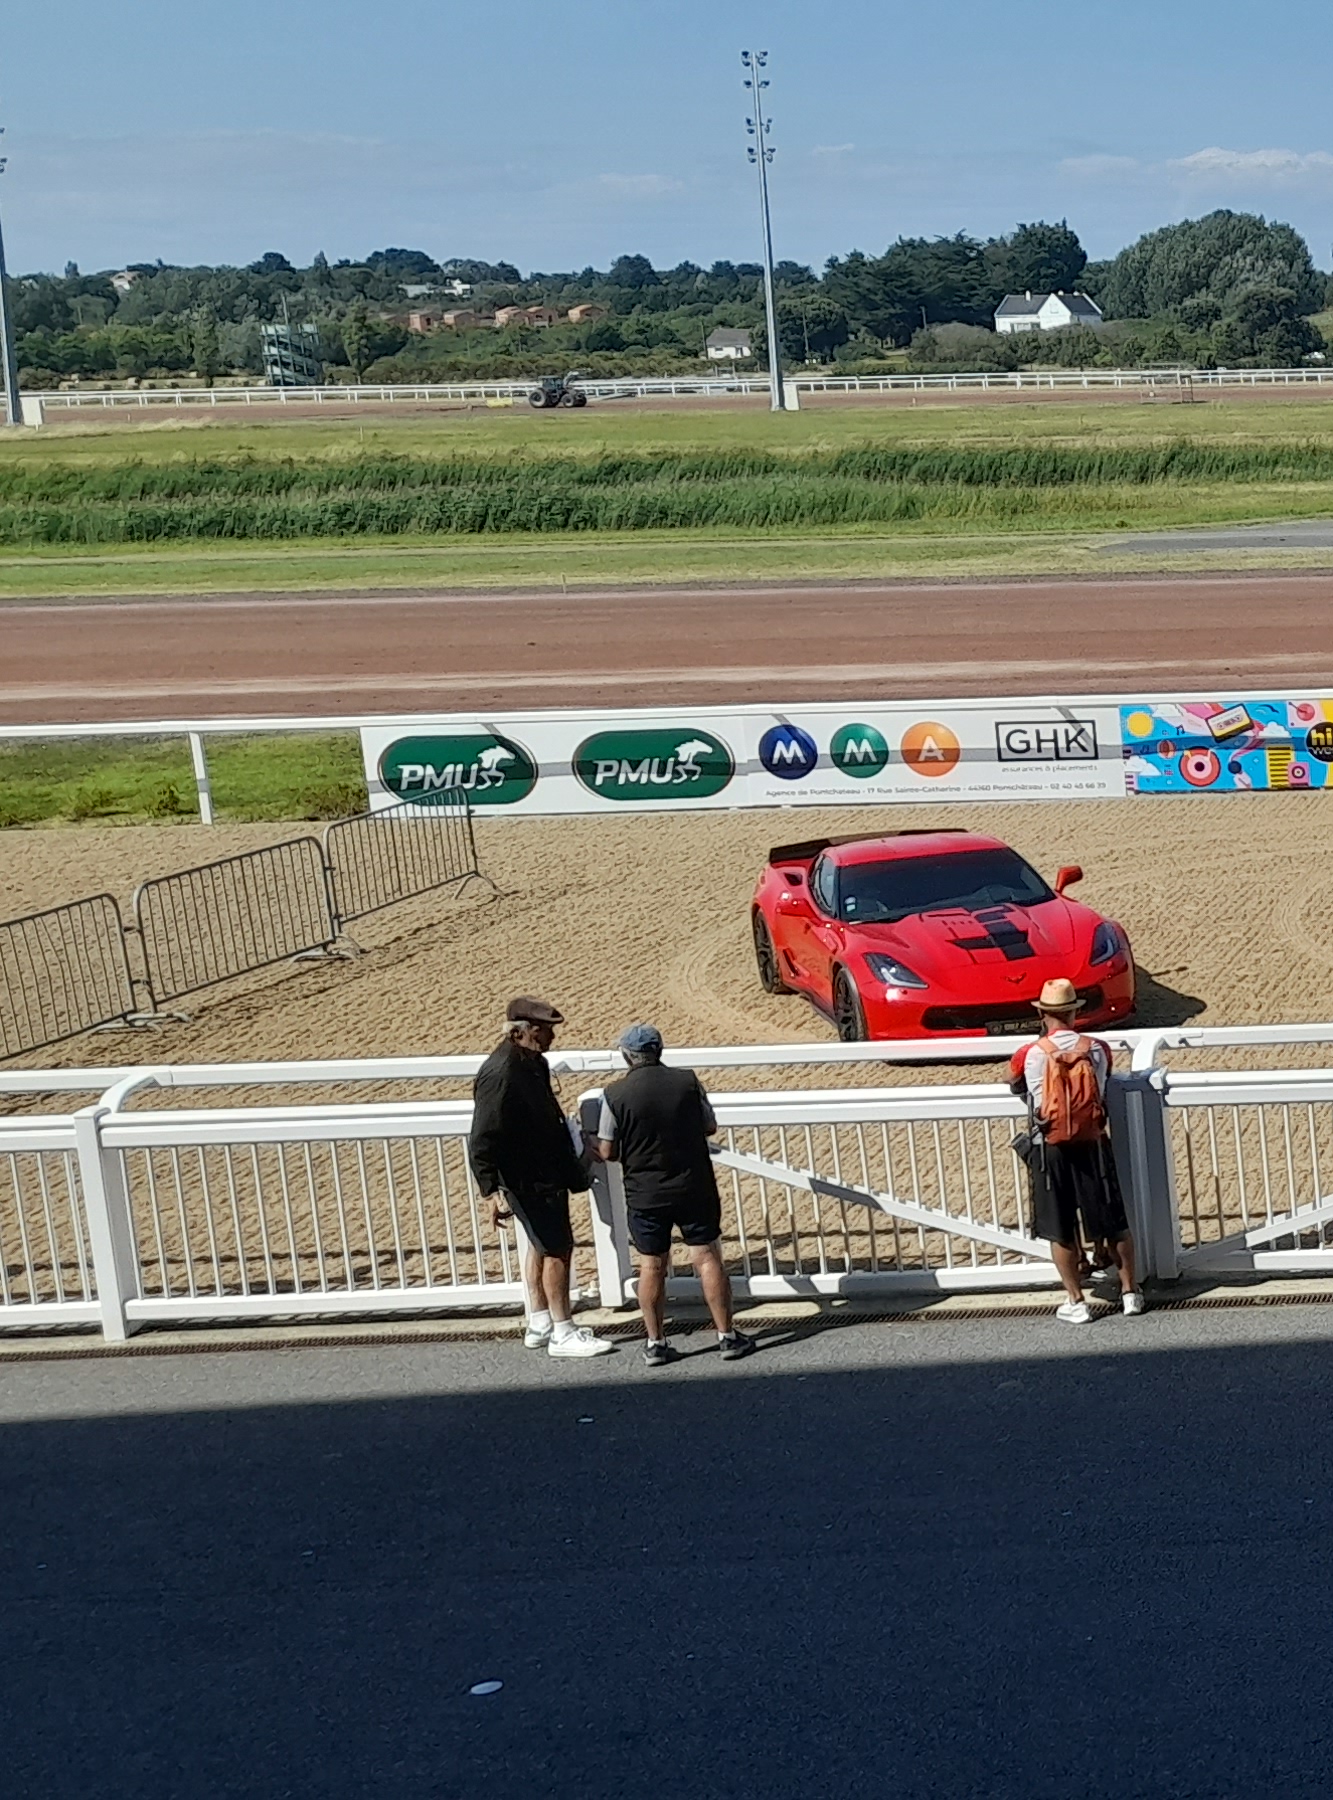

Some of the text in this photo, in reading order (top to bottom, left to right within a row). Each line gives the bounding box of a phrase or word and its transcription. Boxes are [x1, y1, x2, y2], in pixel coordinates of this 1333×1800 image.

[772, 735, 945, 765] M M A
[1005, 728, 1089, 754] GHK
[396, 763, 478, 791] PMU
[593, 757, 675, 787] PMU
[766, 789, 796, 797] Agence
